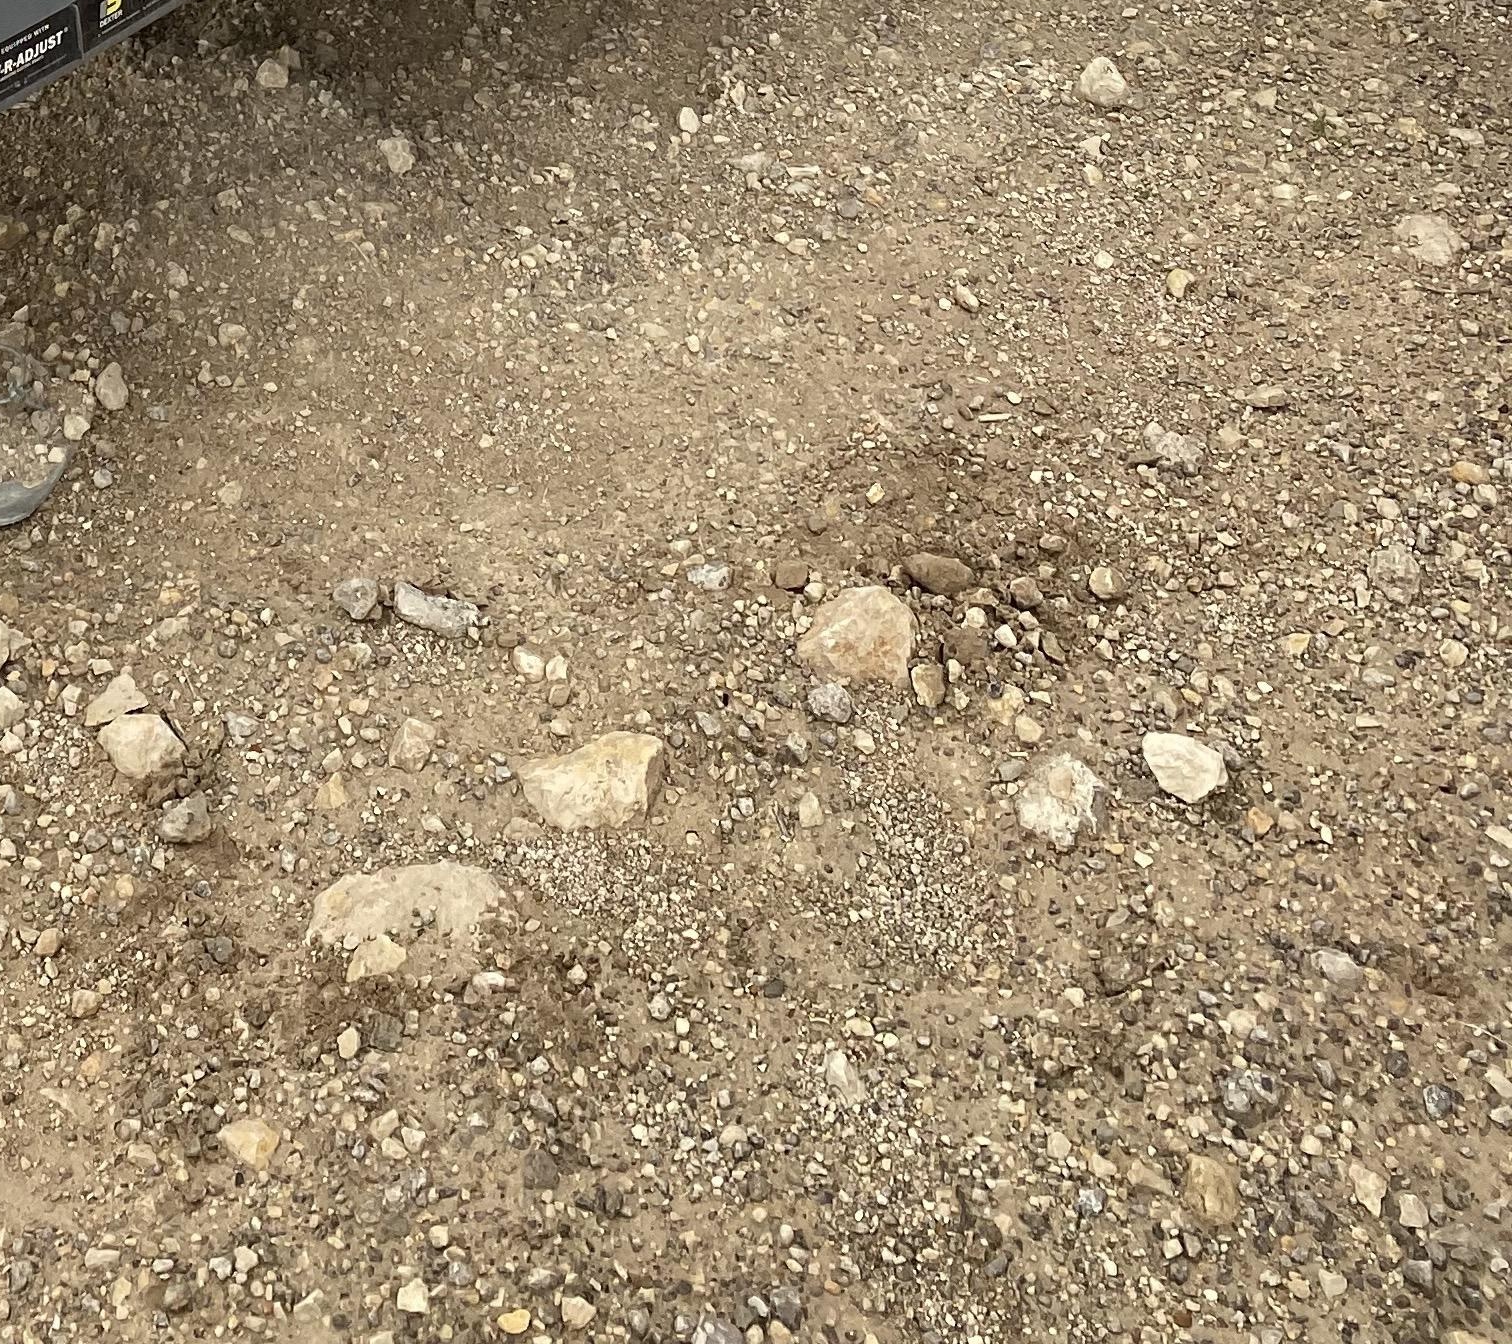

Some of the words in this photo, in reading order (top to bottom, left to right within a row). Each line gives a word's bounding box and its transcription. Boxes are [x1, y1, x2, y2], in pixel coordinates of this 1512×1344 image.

[99, 9, 123, 28] DEXTER
[1, 33, 33, 55] EQUIPPED
[33, 24, 50, 36] WITH
